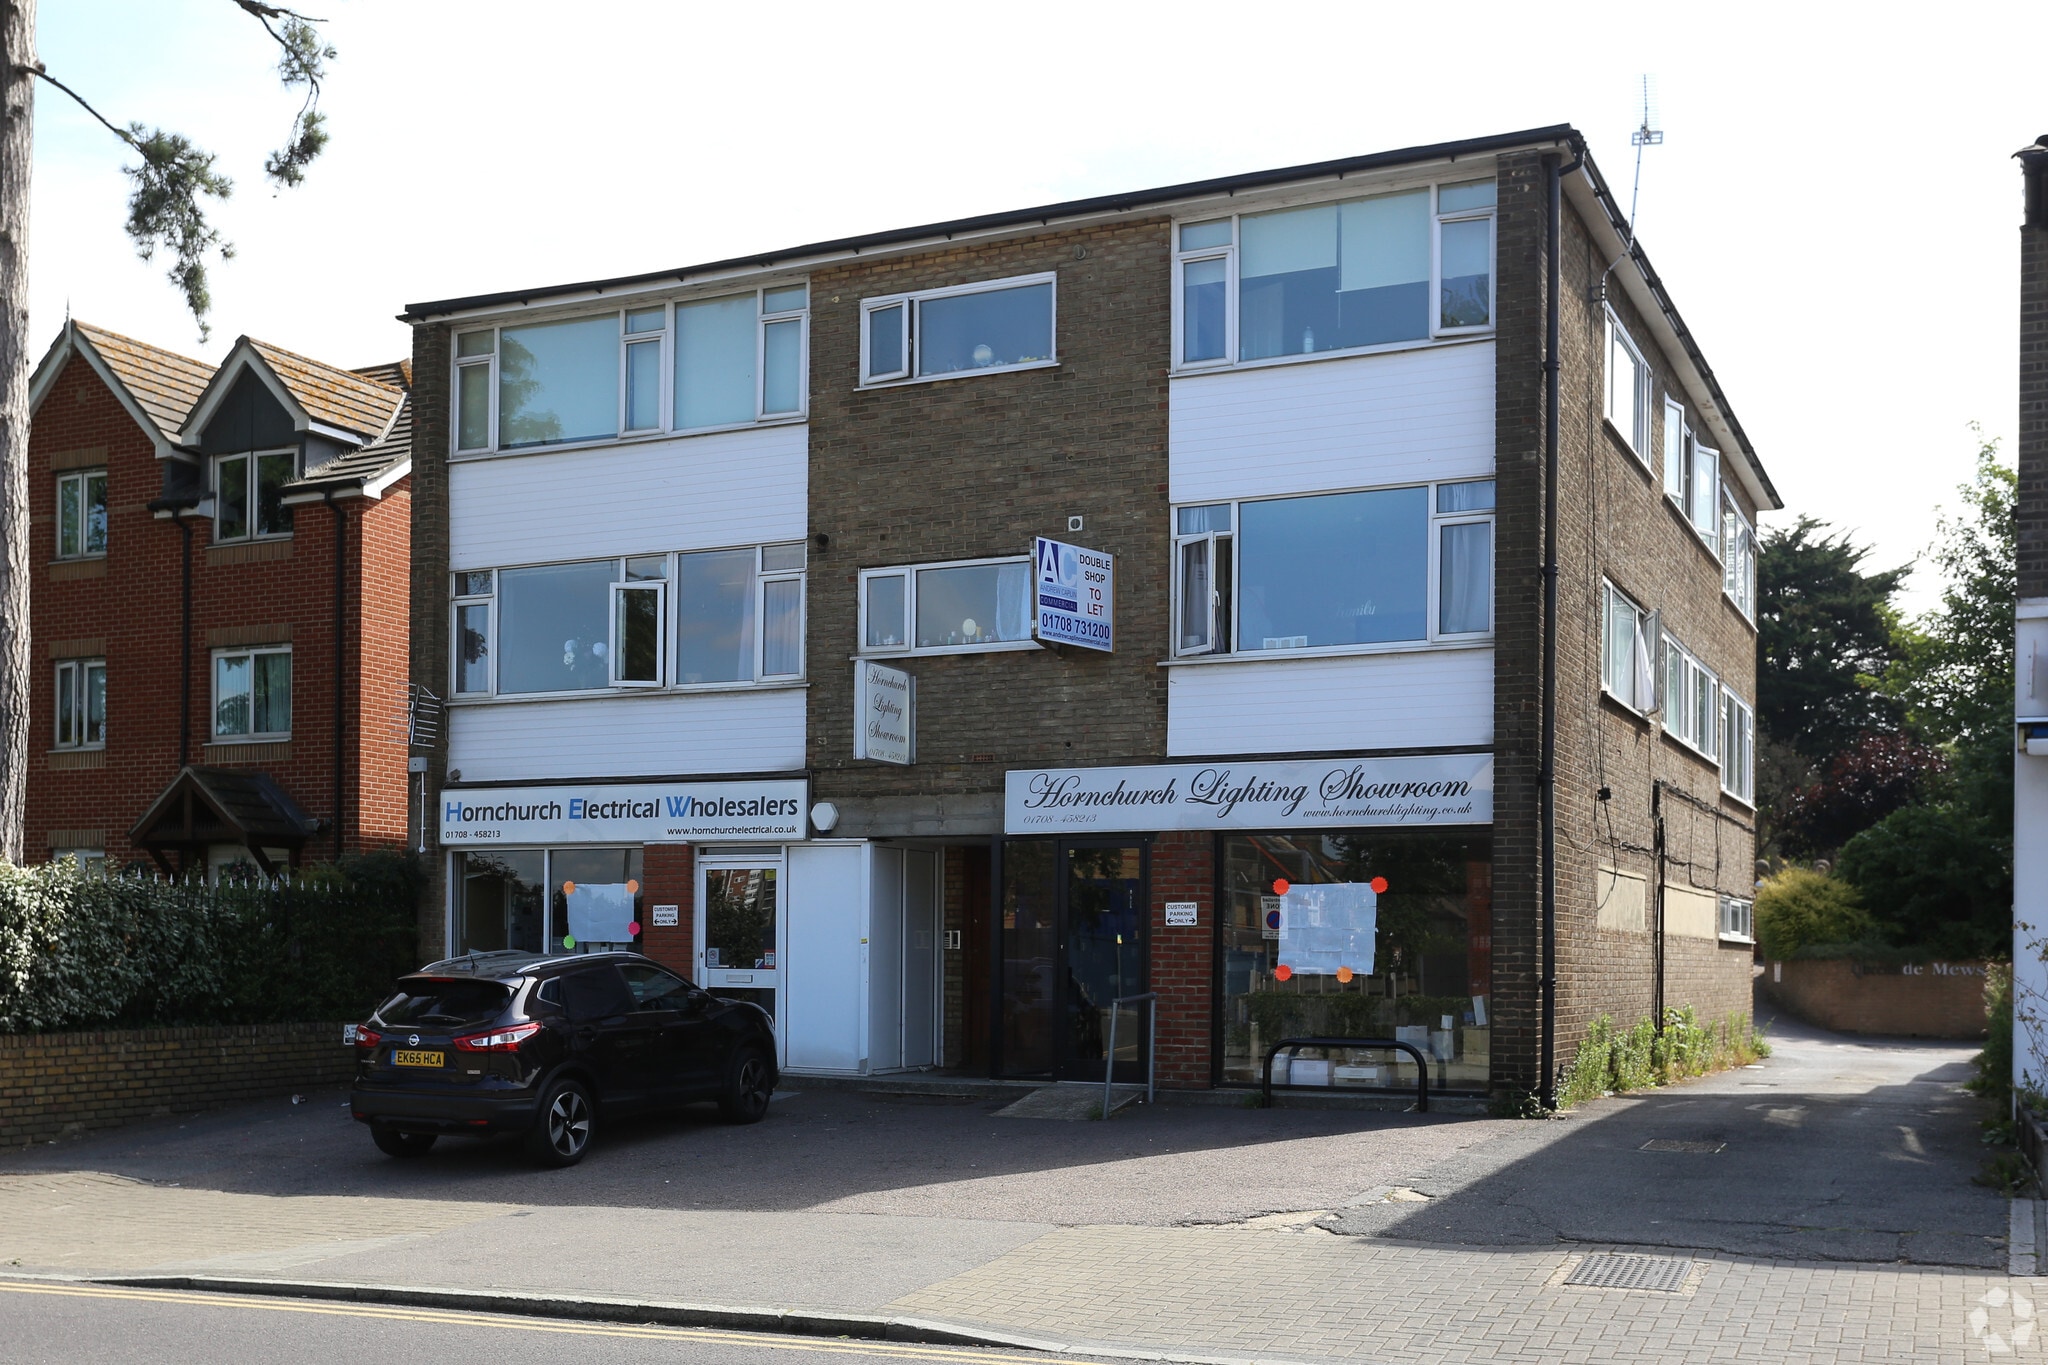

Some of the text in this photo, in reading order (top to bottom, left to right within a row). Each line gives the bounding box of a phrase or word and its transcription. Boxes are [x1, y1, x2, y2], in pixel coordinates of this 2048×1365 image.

[1039, 540, 1077, 587] AC
[1079, 554, 1110, 570] DOUBLE
[1084, 570, 1105, 583] SHOP
[1040, 584, 1060, 595] ANDREW
[1089, 587, 1101, 600] TO
[1040, 596, 1076, 610] COMMERCIAL
[1087, 603, 1103, 616] LET
[1042, 613, 1110, 640] 01708 731200
[1042, 630, 1110, 647] www.andrewcaplincommercial.com
[868, 666, 907, 691] Hornchurch
[873, 693, 902, 721] Lighting
[868, 720, 906, 743] Showroom
[1023, 765, 1472, 818] Hornchurch Lighting Showroom
[445, 795, 798, 822] Hornchurch Electrical Wholesalers
[1302, 803, 1473, 822] www.hornchurchlighting.co.uk
[1023, 815, 1054, 824] 01708
[1060, 813, 1097, 823] 458213
[445, 830, 468, 839] 01708
[474, 829, 501, 838] 458213
[666, 824, 798, 836] www.hornchurchelectrical.co.uk
[1931, 961, 1986, 976] Mews
[397, 1052, 442, 1065] EK65 HCA
